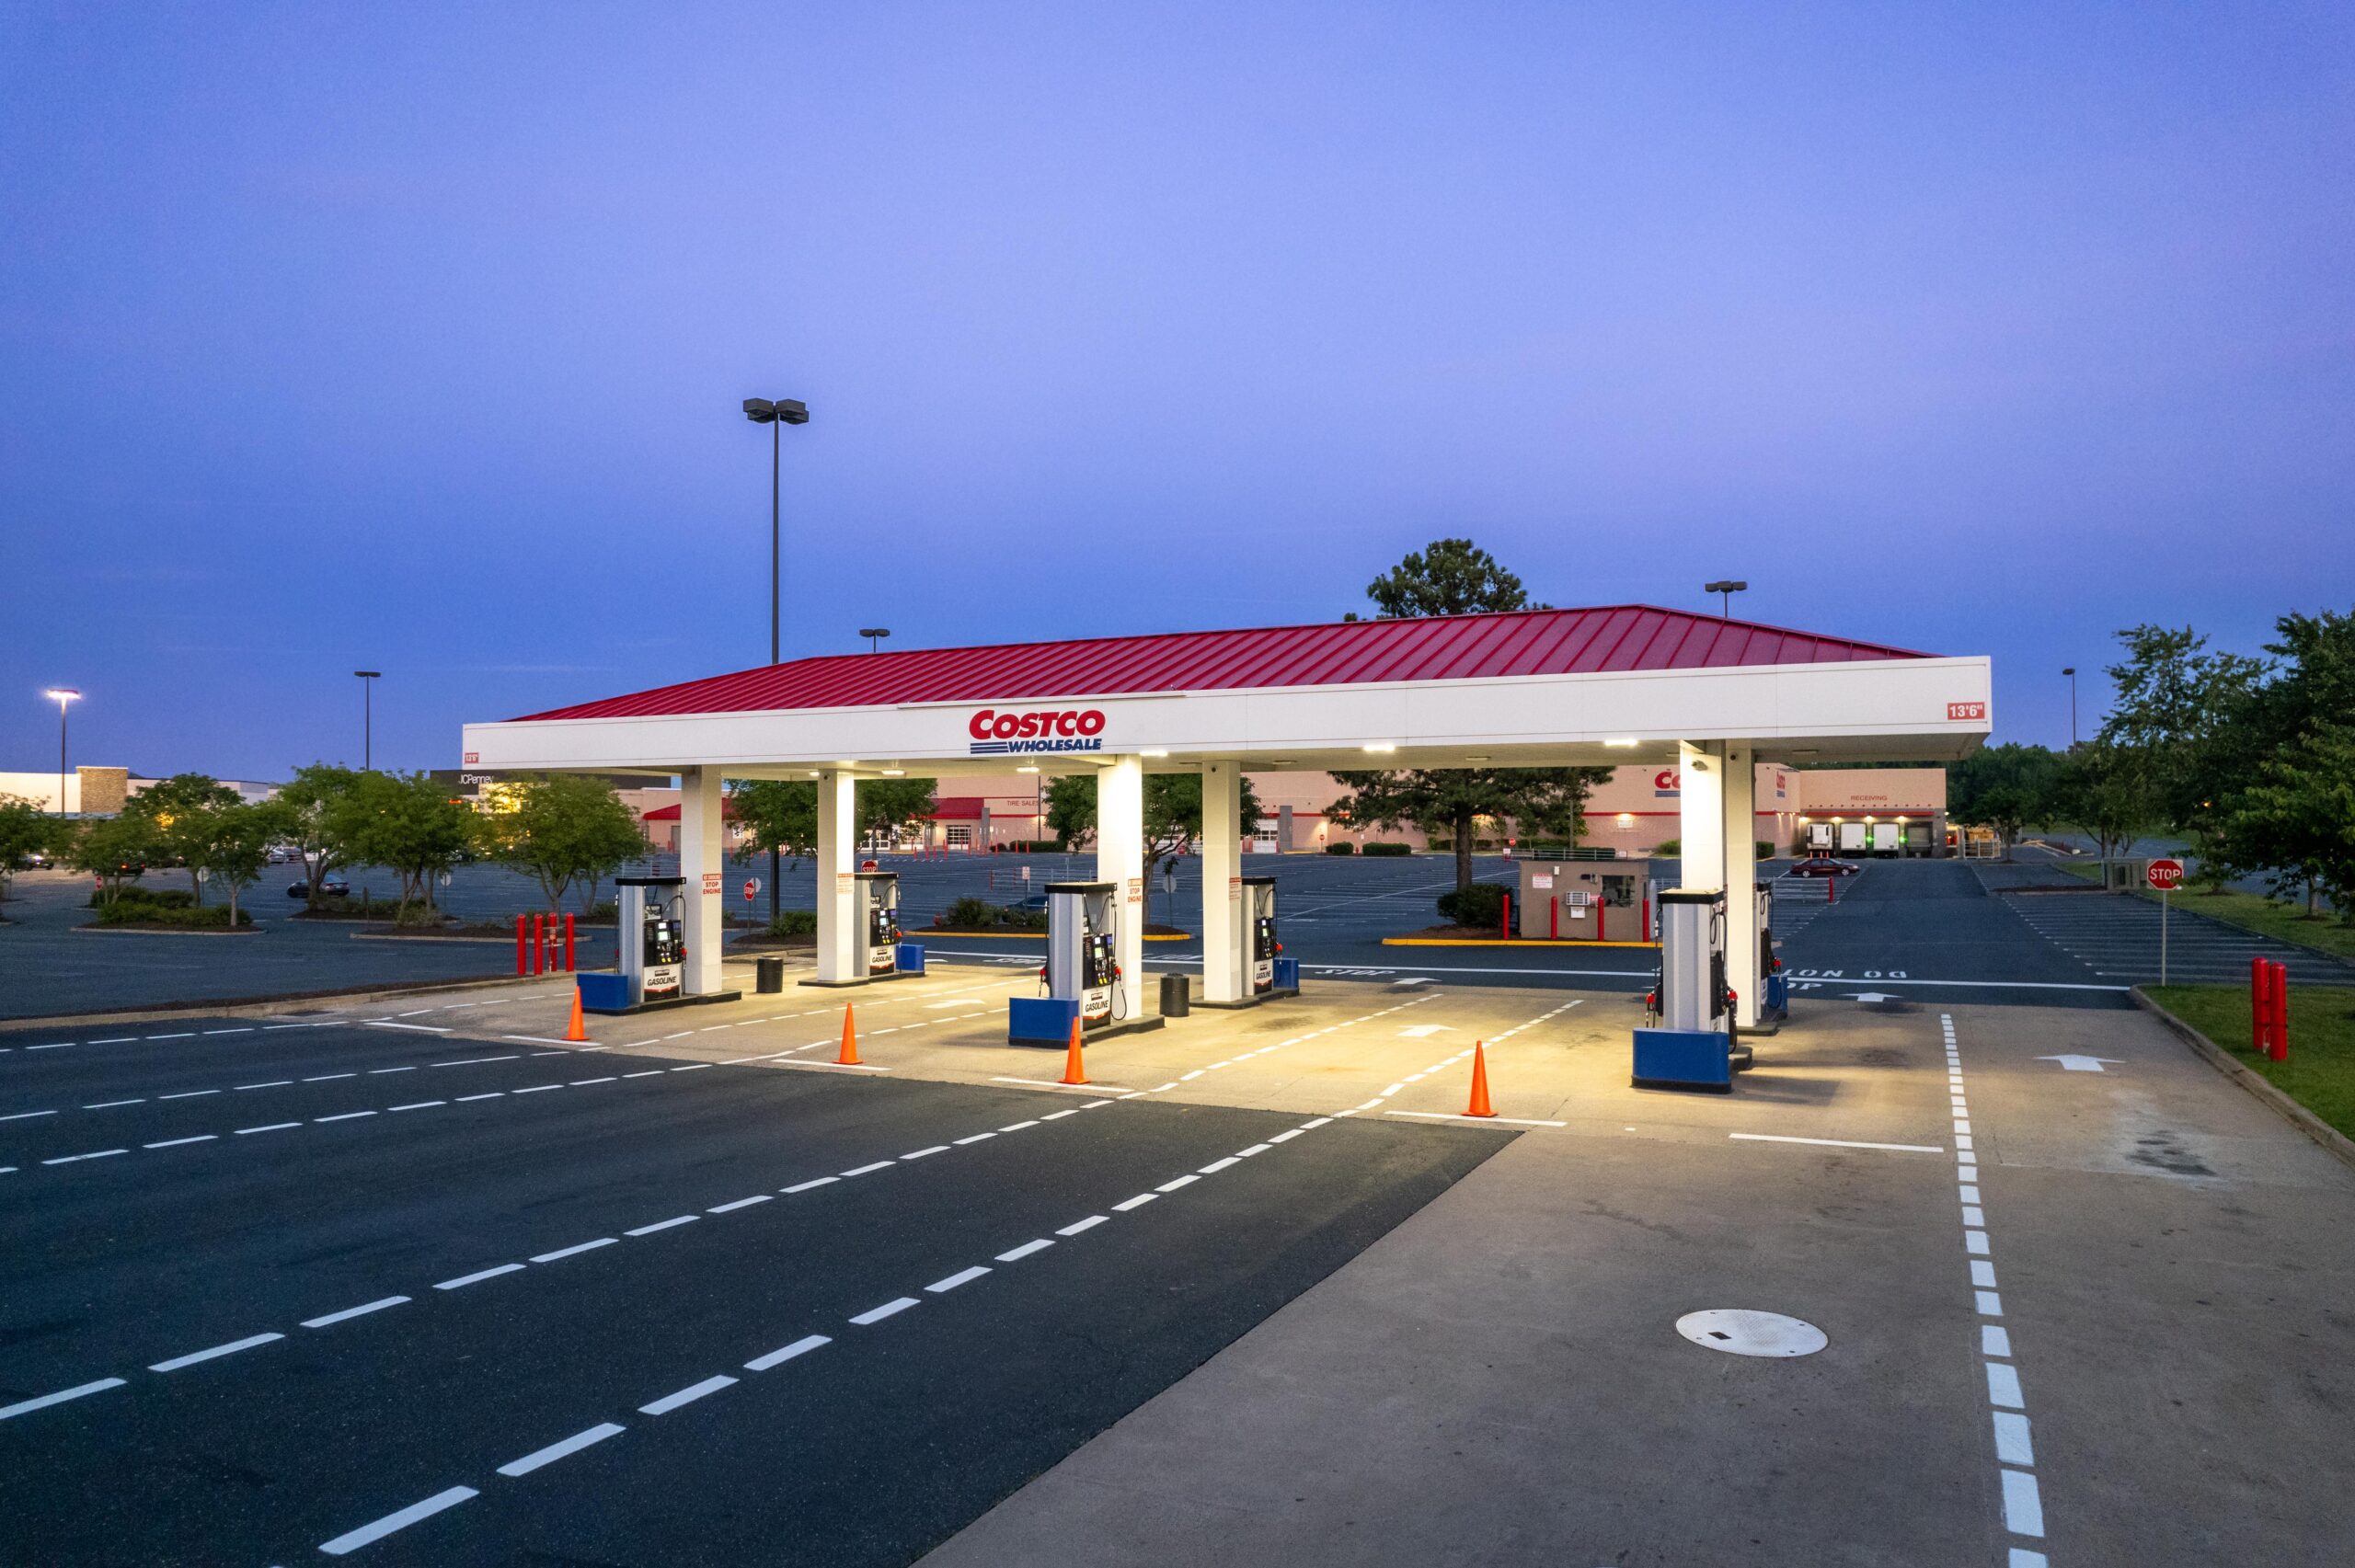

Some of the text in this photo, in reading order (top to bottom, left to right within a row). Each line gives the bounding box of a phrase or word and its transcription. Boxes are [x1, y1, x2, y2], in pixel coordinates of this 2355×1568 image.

[1950, 704, 1982, 717] 13'6"
[969, 709, 1106, 740] COSTCO
[1007, 738, 1102, 753] WHOLESALE
[458, 773, 494, 784] JCPenney
[2150, 868, 2181, 880] STOP
[871, 955, 892, 964] GASOLINE
[1256, 970, 1271, 979] GASOLINE
[1863, 970, 1907, 979] DO
[647, 976, 677, 986] GASOLINE
[1085, 1000, 1109, 1013] GASOLINE
